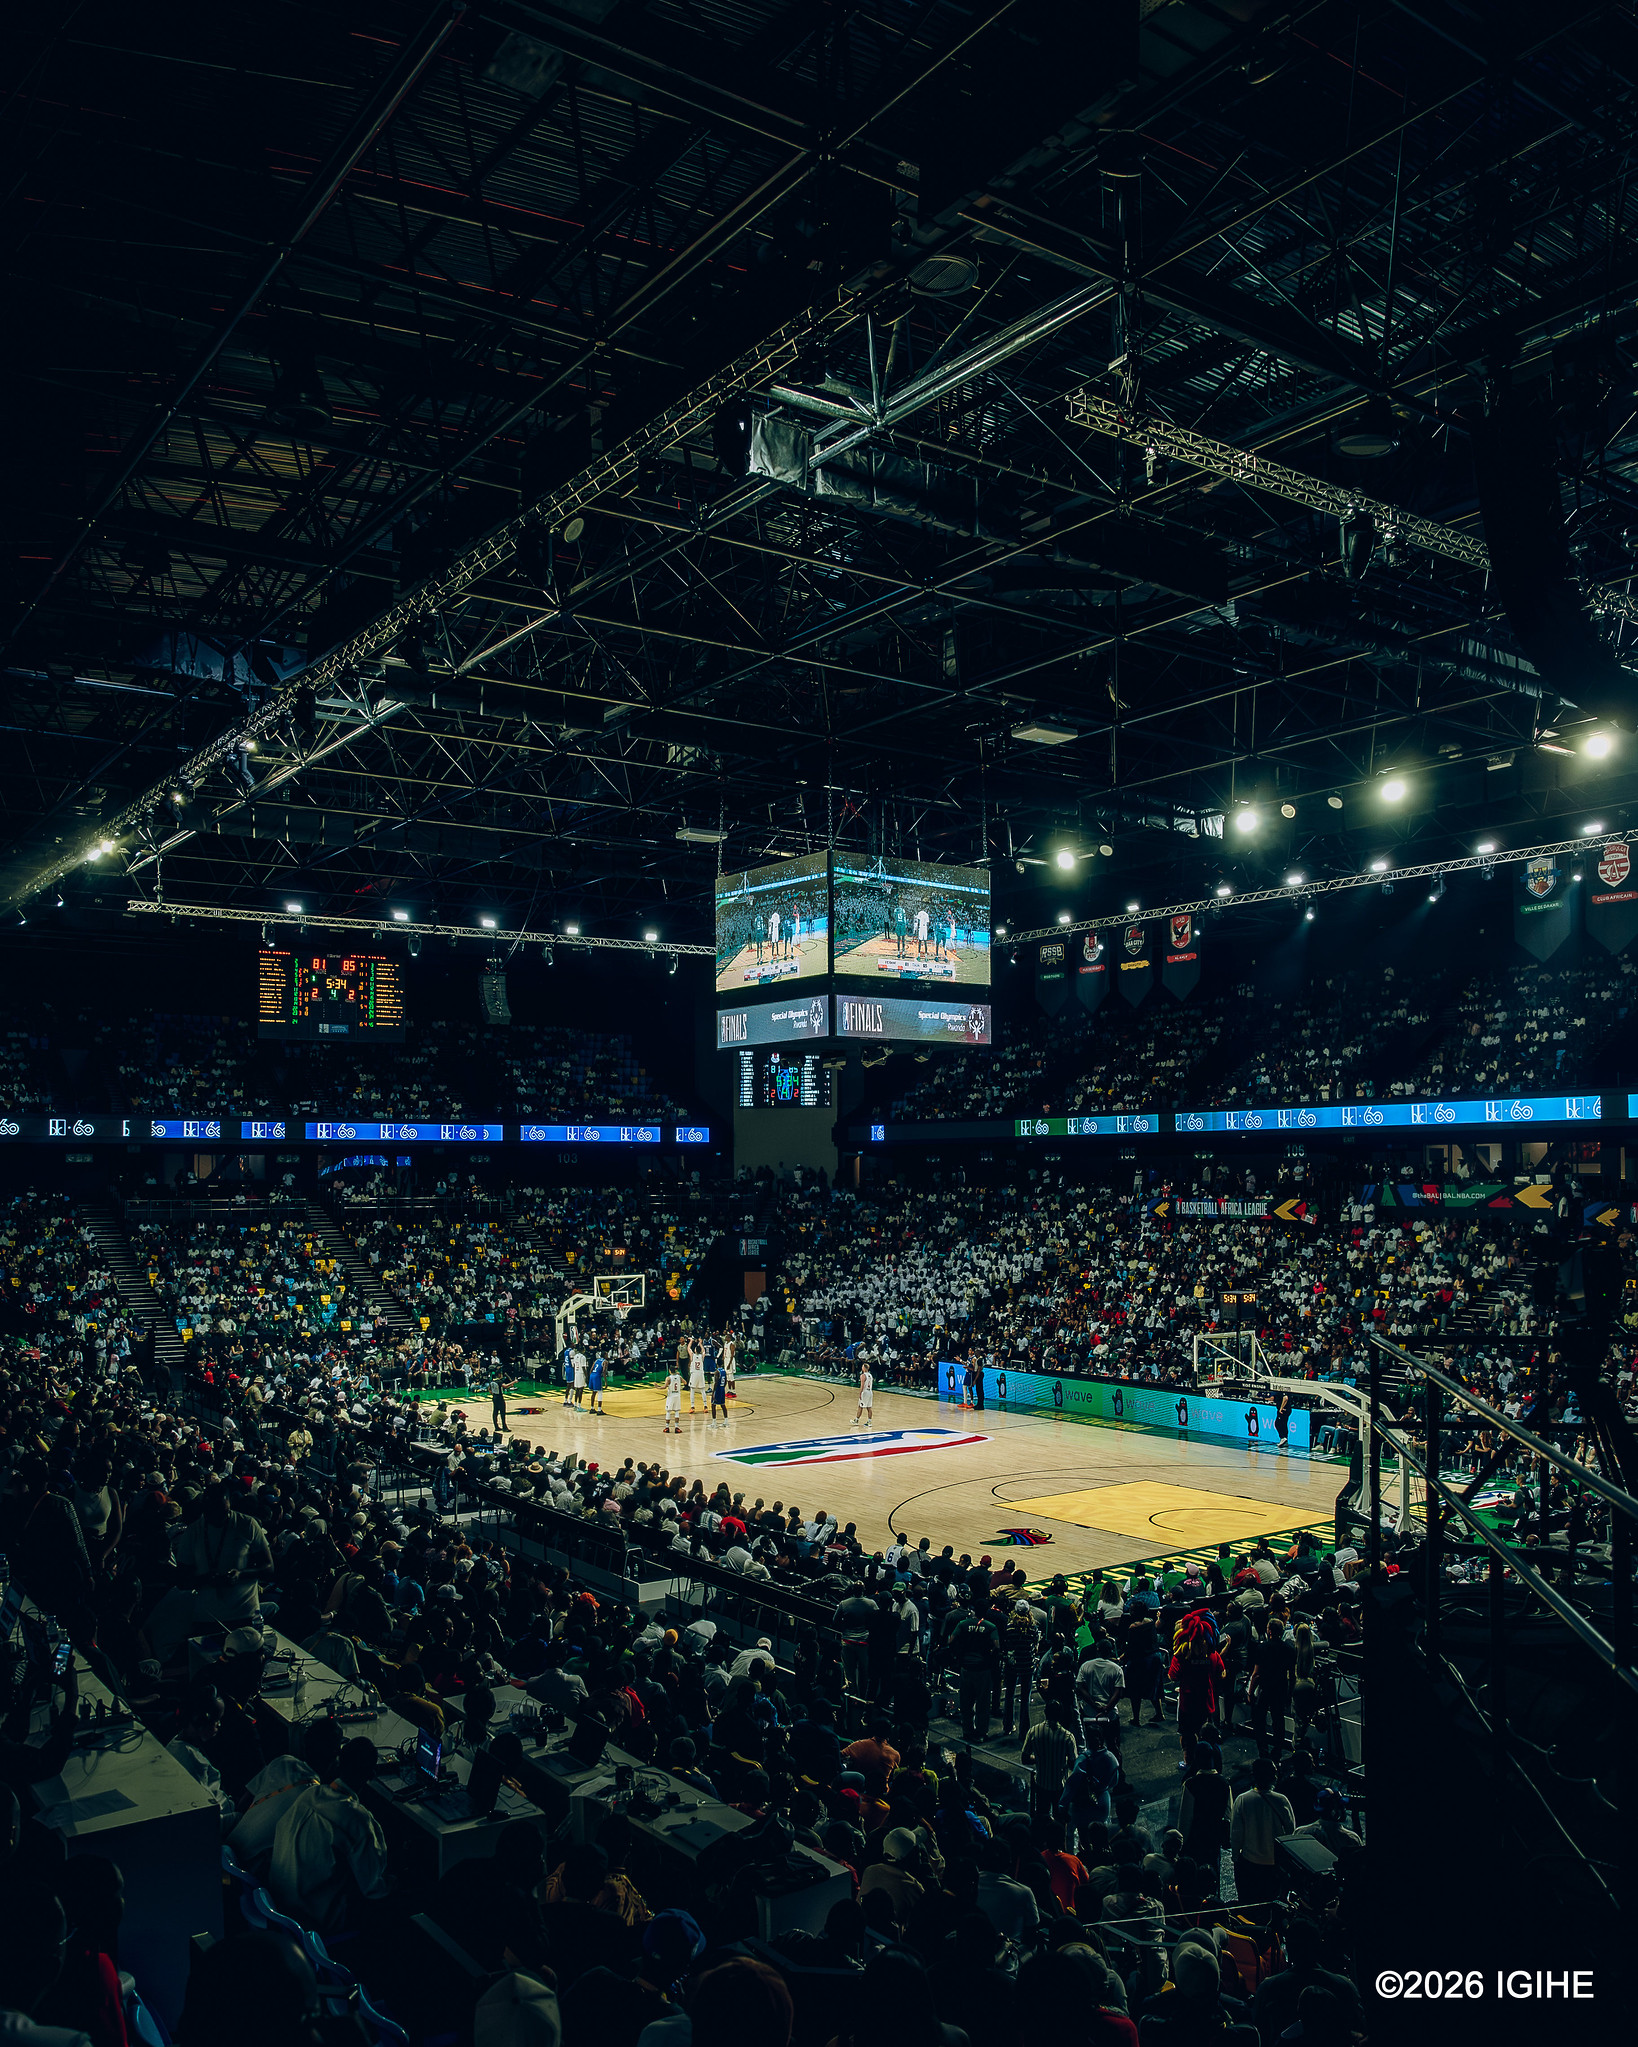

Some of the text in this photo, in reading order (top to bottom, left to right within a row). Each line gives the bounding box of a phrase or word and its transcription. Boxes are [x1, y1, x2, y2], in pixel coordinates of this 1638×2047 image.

[1042, 946, 1062, 958] RSSB
[312, 958, 326, 970] 81
[343, 960, 355, 971] 85
[326, 978, 346, 989] 5:34
[312, 988, 318, 998] 2
[331, 989, 336, 998] 4
[348, 990, 354, 999] 2
[771, 1008, 808, 1022] Special Olympics
[850, 1003, 882, 1032] FINALS
[918, 1011, 966, 1022] Special Olympics
[726, 1014, 747, 1042] FINALS
[793, 1018, 808, 1028] Rwanda
[948, 1023, 966, 1032] Rwanda
[771, 1065, 780, 1073] 81
[776, 1076, 799, 1086] 5:34
[771, 1089, 776, 1097] 2
[794, 1089, 799, 1097] 2
[1364, 1107, 1383, 1124] 60
[1434, 1104, 1455, 1123] 60
[1510, 1101, 1533, 1120] 60
[1133, 1116, 1148, 1132] 60
[1187, 1114, 1204, 1130] 60
[1245, 1112, 1262, 1128] 60
[1298, 1109, 1316, 1127] 60
[73, 1120, 94, 1136] 60
[338, 1124, 356, 1139] 60
[400, 1124, 418, 1139] 60
[460, 1124, 476, 1139] 60
[1035, 1120, 1049, 1134] 60
[1082, 1118, 1097, 1133] 60
[529, 1126, 546, 1140] 60
[584, 1127, 600, 1140] 60
[637, 1127, 652, 1141] 60
[688, 1128, 703, 1141] 60
[1120, 1147, 1135, 1159] 105
[1286, 1144, 1305, 1157] 106
[558, 1153, 578, 1163] 103
[1181, 1201, 1267, 1216] BASKETBALL AFRICA LEAGUE
[1224, 1295, 1236, 1303] 5:34
[1243, 1294, 1255, 1303] 5:34
[695, 1361, 700, 1370] 12
[1064, 1390, 1093, 1403] wave
[1126, 1399, 1155, 1413] wave
[1191, 1408, 1223, 1422] wave
[1262, 1417, 1296, 1433] we
[887, 1552, 894, 1562] 6
